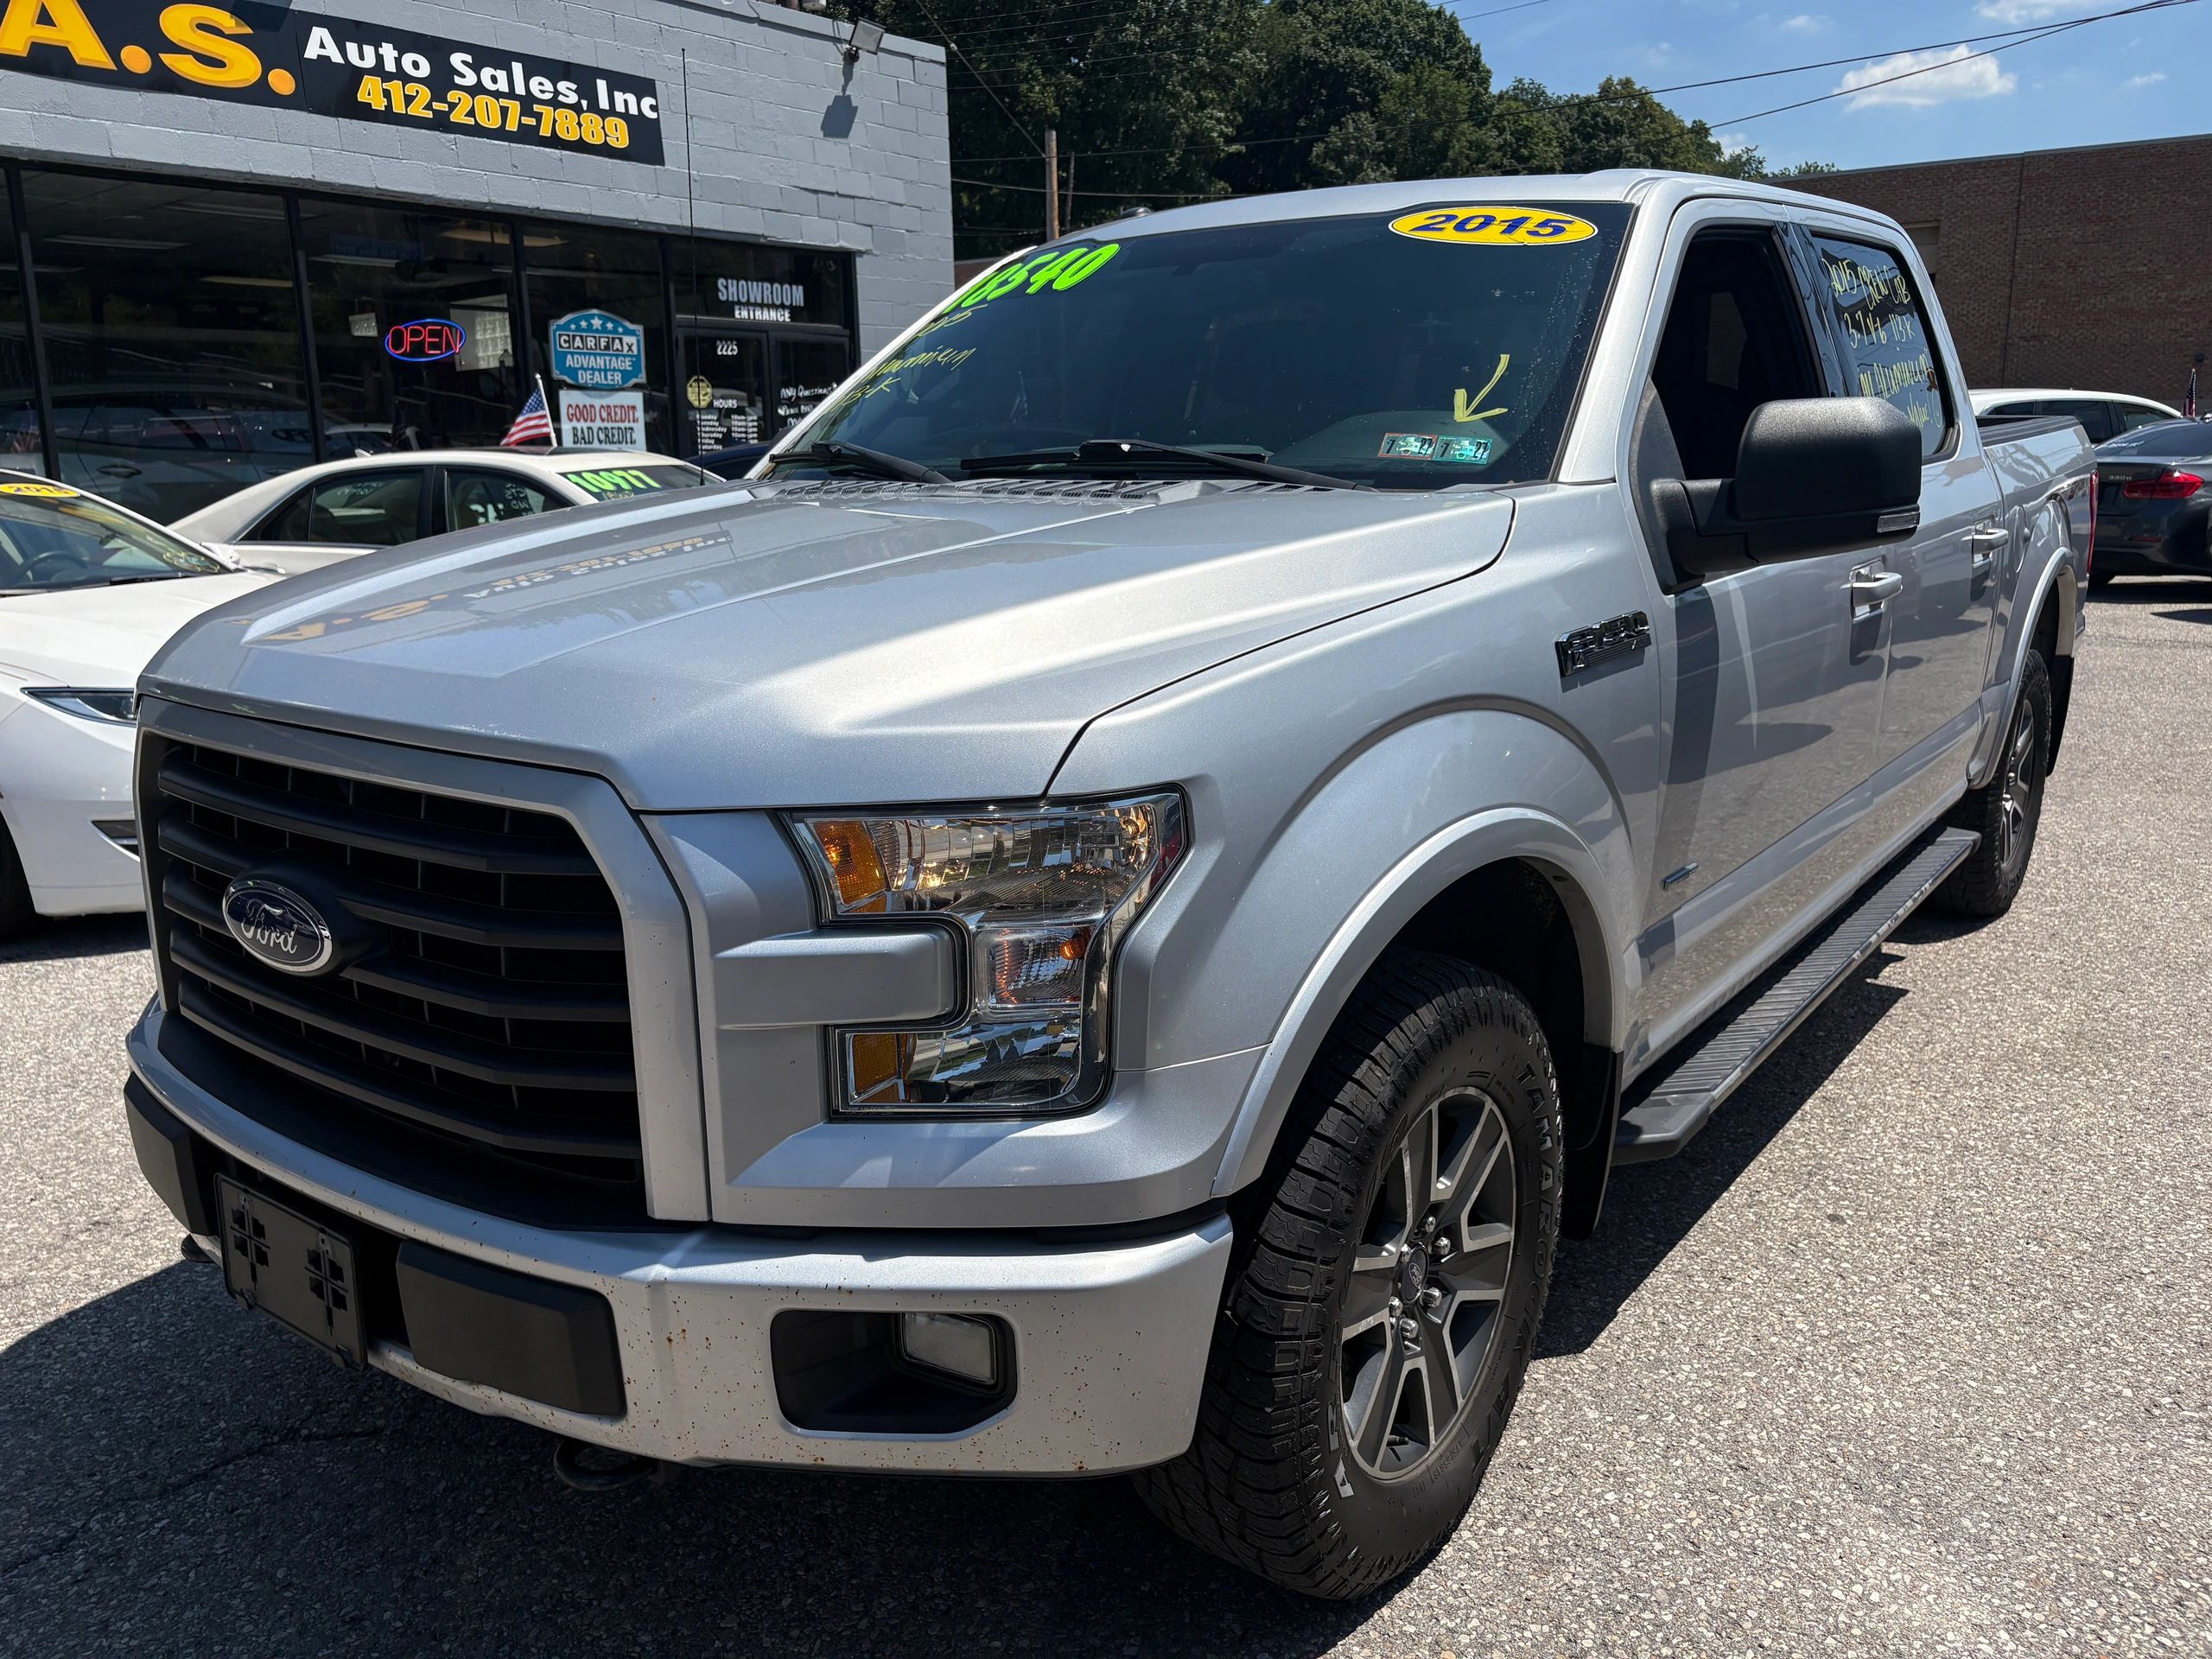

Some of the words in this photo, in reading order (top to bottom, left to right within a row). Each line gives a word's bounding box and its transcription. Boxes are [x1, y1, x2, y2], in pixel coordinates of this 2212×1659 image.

[303, 26, 431, 78] Auto
[449, 52, 588, 111] Sales,
[595, 79, 658, 119] Inc
[357, 74, 630, 149] 412-207-7889
[1408, 213, 1576, 238] 2015
[1821, 258, 1857, 297] 2015
[1884, 265, 1910, 304] CAB
[717, 278, 804, 307] SHOWROOM
[734, 305, 791, 322] ENTRANCE
[389, 325, 461, 354] OPEN
[560, 335, 634, 353] CARFAX
[715, 340, 738, 355] 2225
[565, 354, 633, 371] ADVANTAGE
[578, 370, 622, 385] DEALER
[566, 404, 597, 423] GOOD
[713, 398, 738, 409] HOURS
[571, 426, 594, 445] BAD
[566, 469, 663, 493] 10977
[240, 899, 298, 955] Ford
